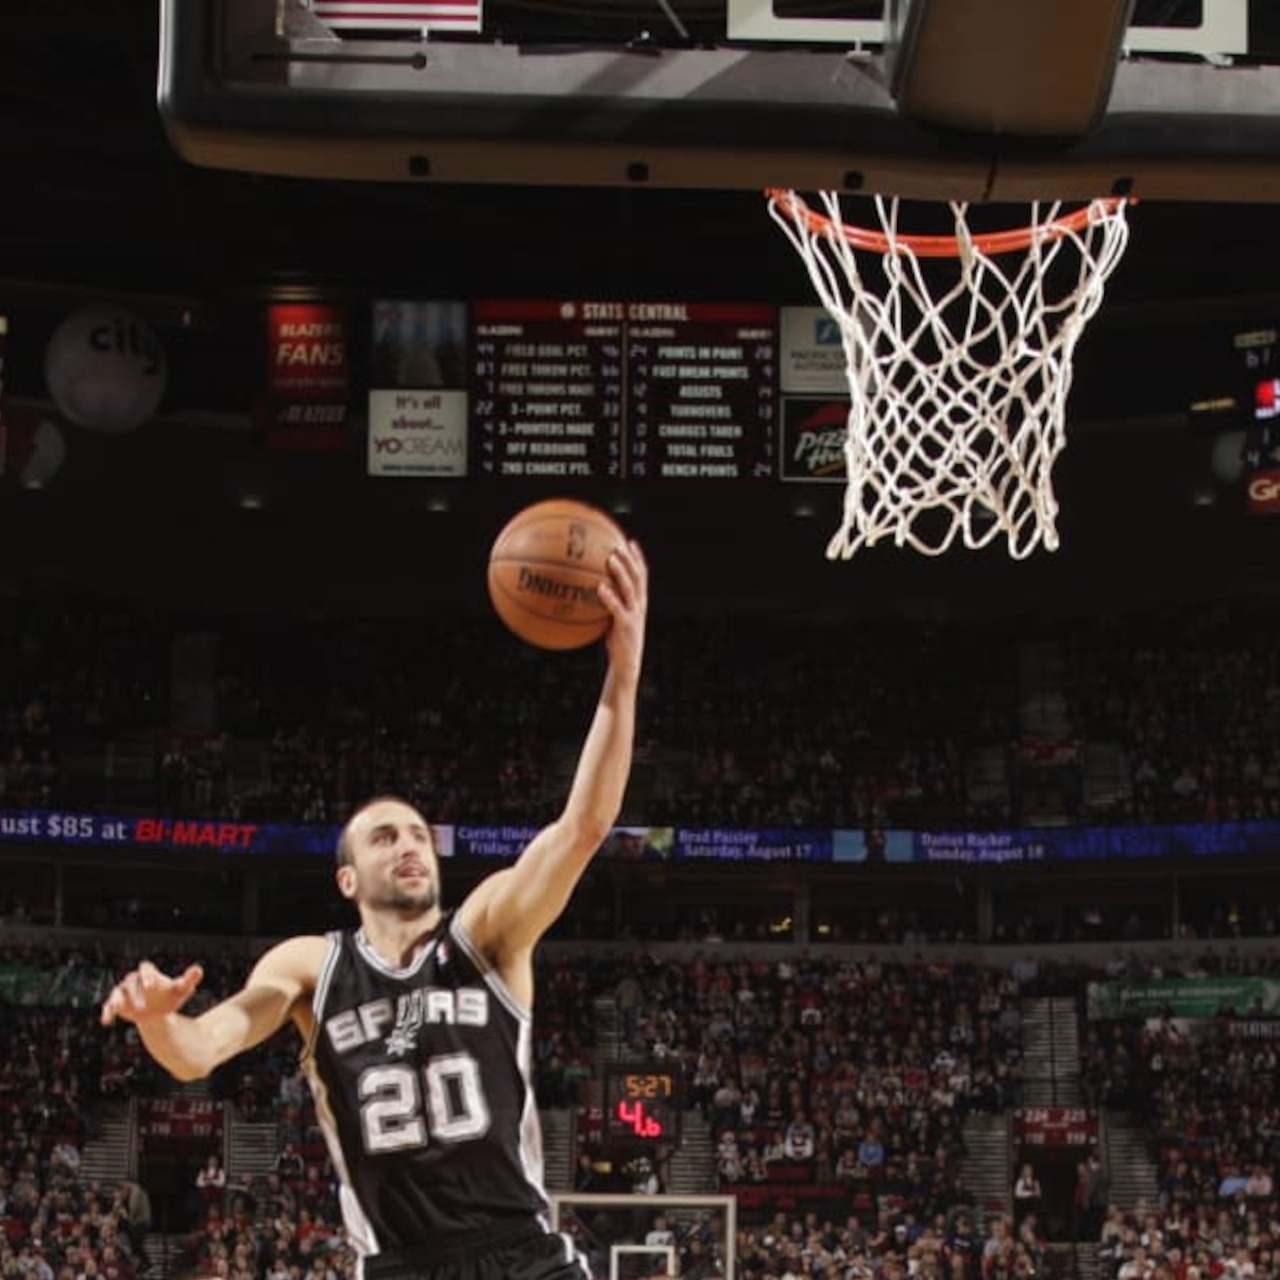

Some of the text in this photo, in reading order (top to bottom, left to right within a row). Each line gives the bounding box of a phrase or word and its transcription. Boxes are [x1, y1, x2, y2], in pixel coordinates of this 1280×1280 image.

[582, 301, 689, 322] STATS CENTRAL
[276, 342, 343, 366] FANS
[396, 396, 419, 410] It's
[46, 815, 94, 839] $85
[100, 818, 127, 841] at
[134, 816, 258, 849] BI-MART
[357, 1052, 492, 1156] 20
